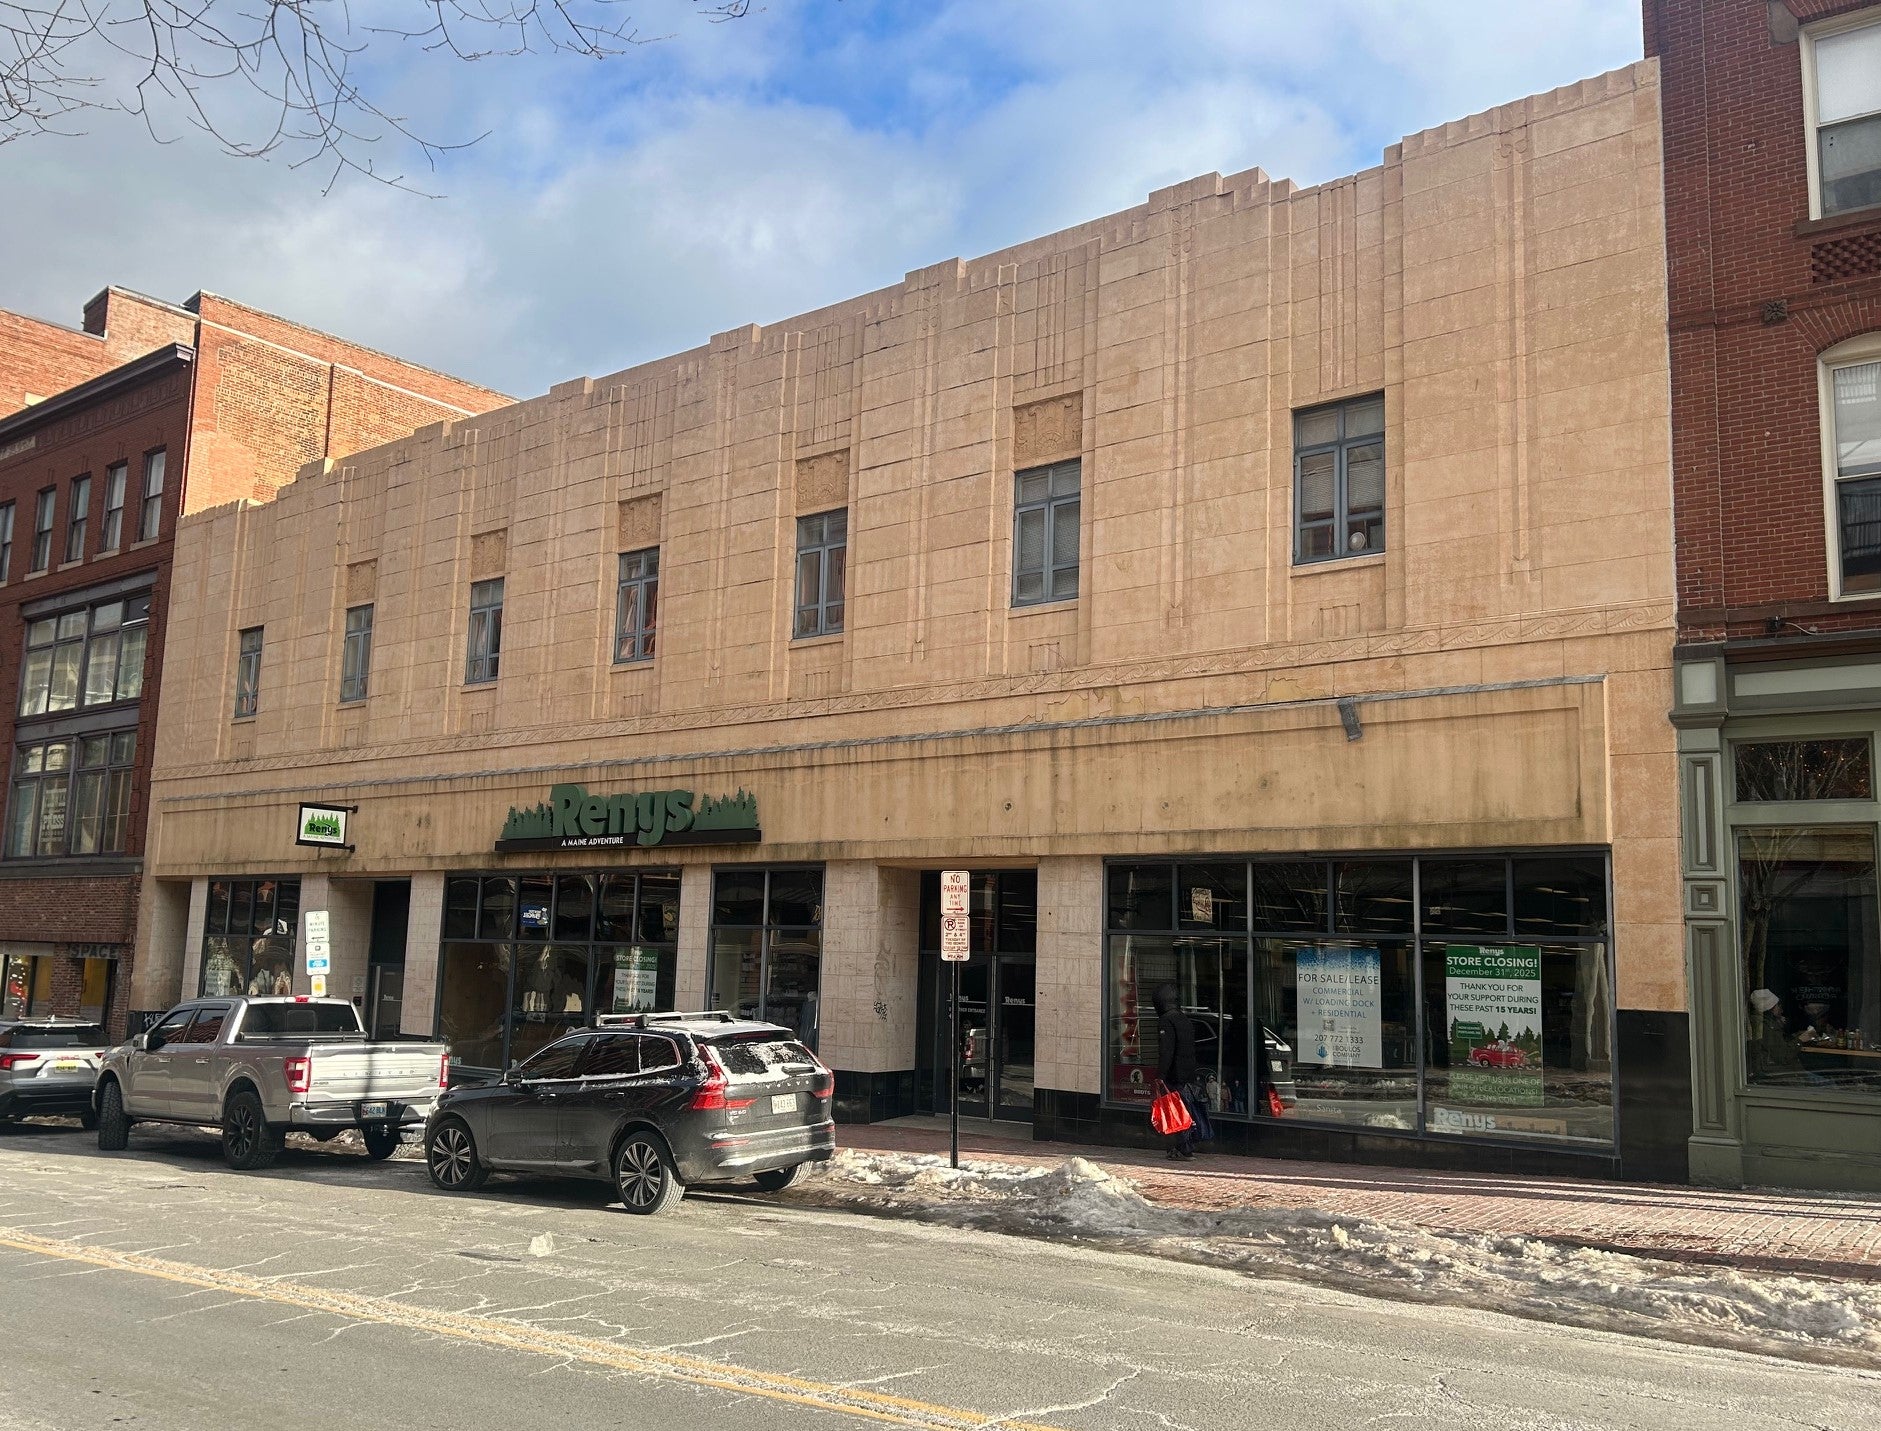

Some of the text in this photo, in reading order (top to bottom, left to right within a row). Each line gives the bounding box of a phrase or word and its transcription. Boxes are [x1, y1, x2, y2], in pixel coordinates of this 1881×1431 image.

[550, 784, 696, 846] Renys
[309, 823, 338, 836] Renys
[561, 836, 624, 847] A MAINE ADVENTURE
[950, 875, 961, 884] NO
[943, 884, 968, 893] PARKING
[69, 943, 118, 958] SPACE
[1479, 947, 1504, 956] Renys
[1446, 956, 1537, 968] STORE CLOSING!
[1449, 967, 1492, 976] December
[1514, 969, 1536, 977] 2025
[1298, 973, 1379, 985] FOR SALE/LEASE
[1312, 987, 1364, 996] COMMERCIAL
[1460, 982, 1524, 992] THANK YOU FOR
[1315, 998, 1350, 1006] LOADING
[1352, 1000, 1375, 1008] DOCK
[1447, 993, 1539, 1003] YOUR SUPPORT DURING
[1318, 1009, 1367, 1018] RESIDENTIAL
[1449, 1003, 1474, 1012] THESE
[1475, 1004, 1494, 1013] PAST
[1507, 1006, 1537, 1015] YEARS!
[1314, 1034, 1328, 1042] 207
[1330, 1035, 1343, 1043] 772
[1449, 1072, 1474, 1081] PLEASE
[1475, 1074, 1491, 1082] VISIT
[1512, 1077, 1529, 1085] ONE
[766, 1080, 809, 1089] VOLVO
[1433, 1107, 1496, 1132] Renys
